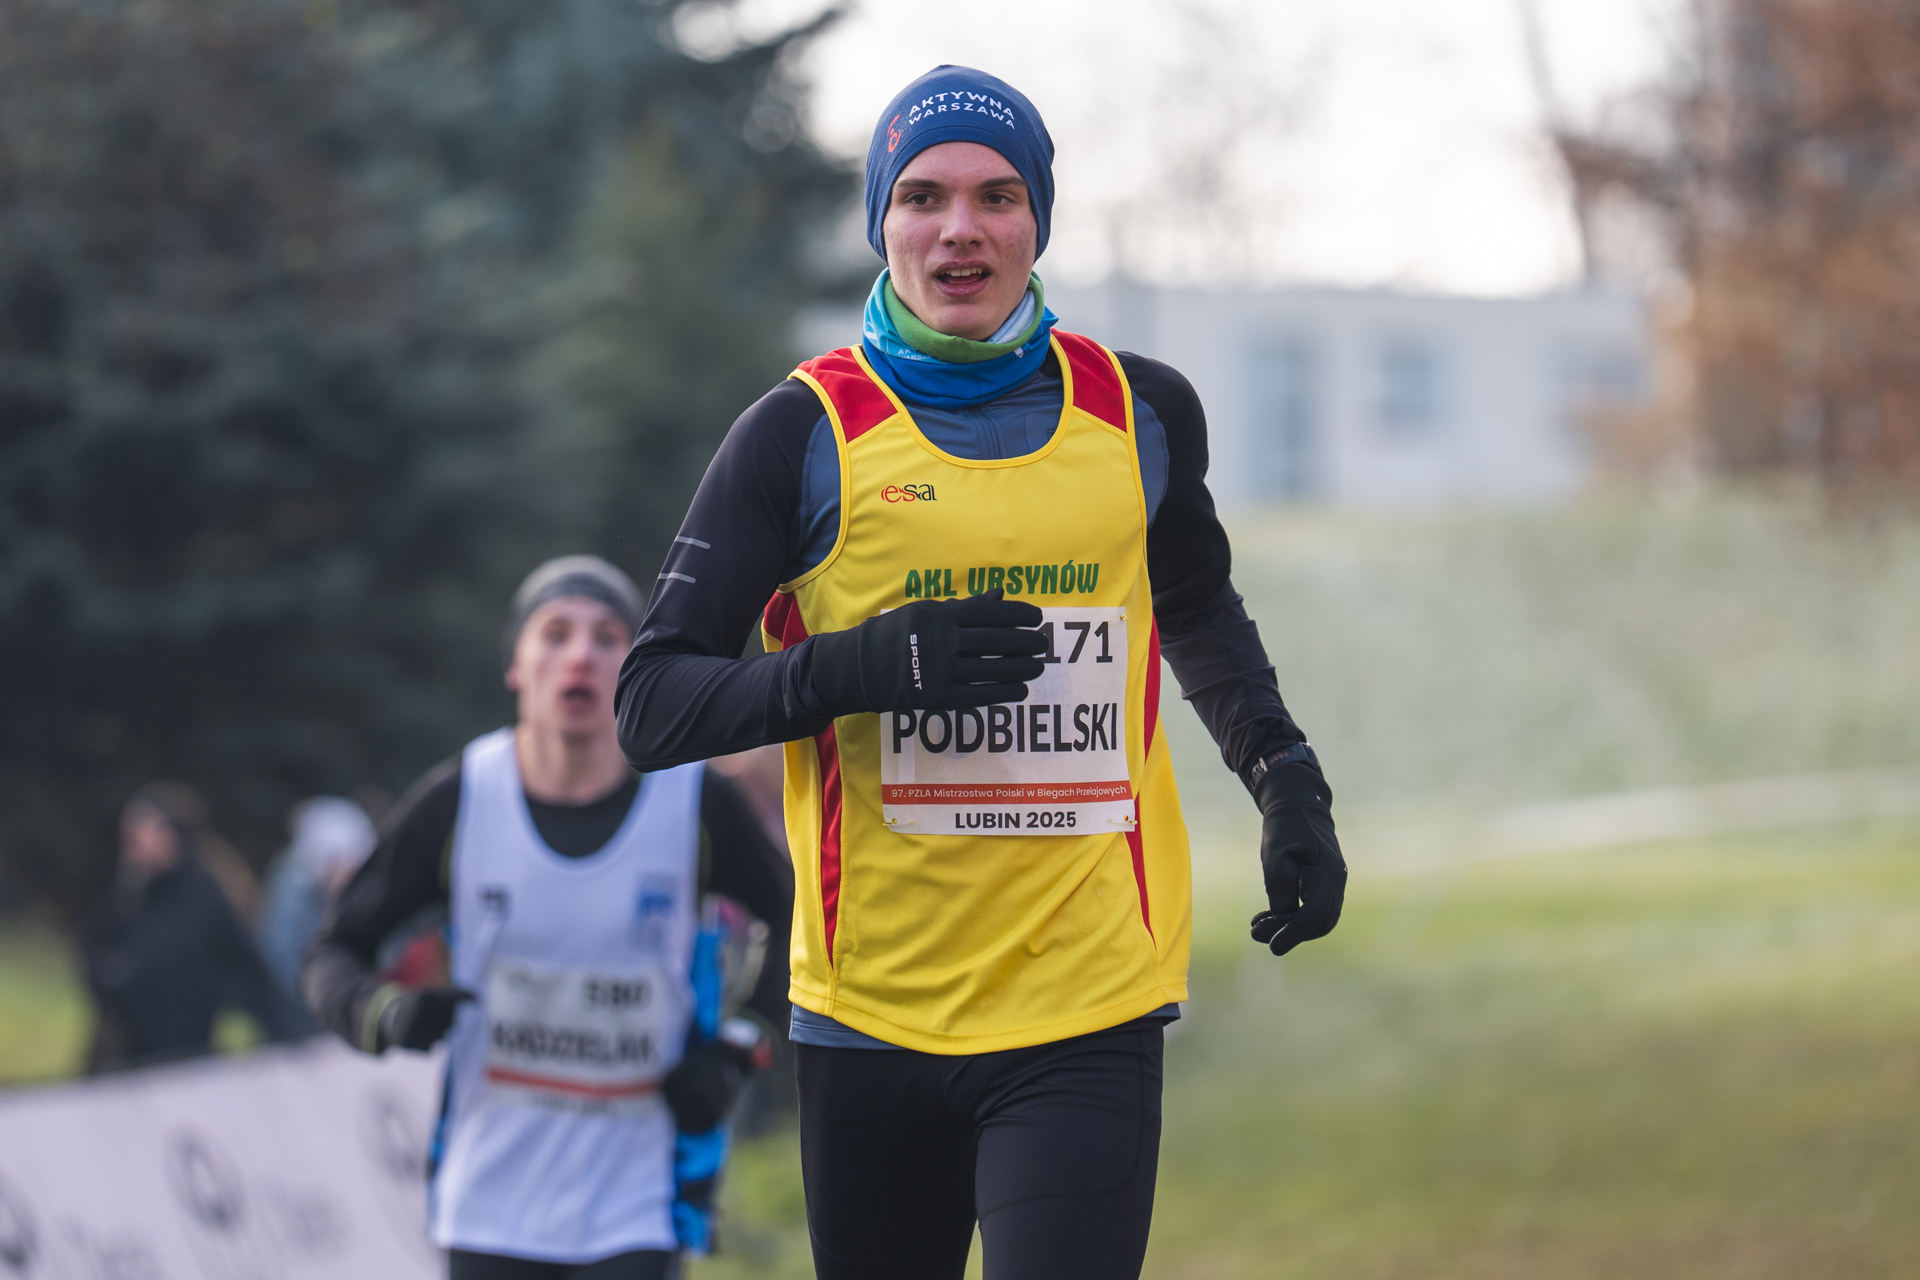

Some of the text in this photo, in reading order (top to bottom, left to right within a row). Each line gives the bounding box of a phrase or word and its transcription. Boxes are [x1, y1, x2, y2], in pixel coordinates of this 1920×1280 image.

[908, 91, 1015, 120] AKTYWNA
[908, 102, 1016, 130] WARSZAWA
[904, 559, 1100, 598] AKL URSYNÓW
[1033, 620, 1113, 664] 171
[909, 633, 923, 691] SPORT
[892, 702, 1118, 754] PODBIELSKI
[891, 785, 1127, 799] 97. PZLA Mistrzostwa Polski w Biegach Przełajowych
[955, 811, 1077, 829] LUBIN 2025
